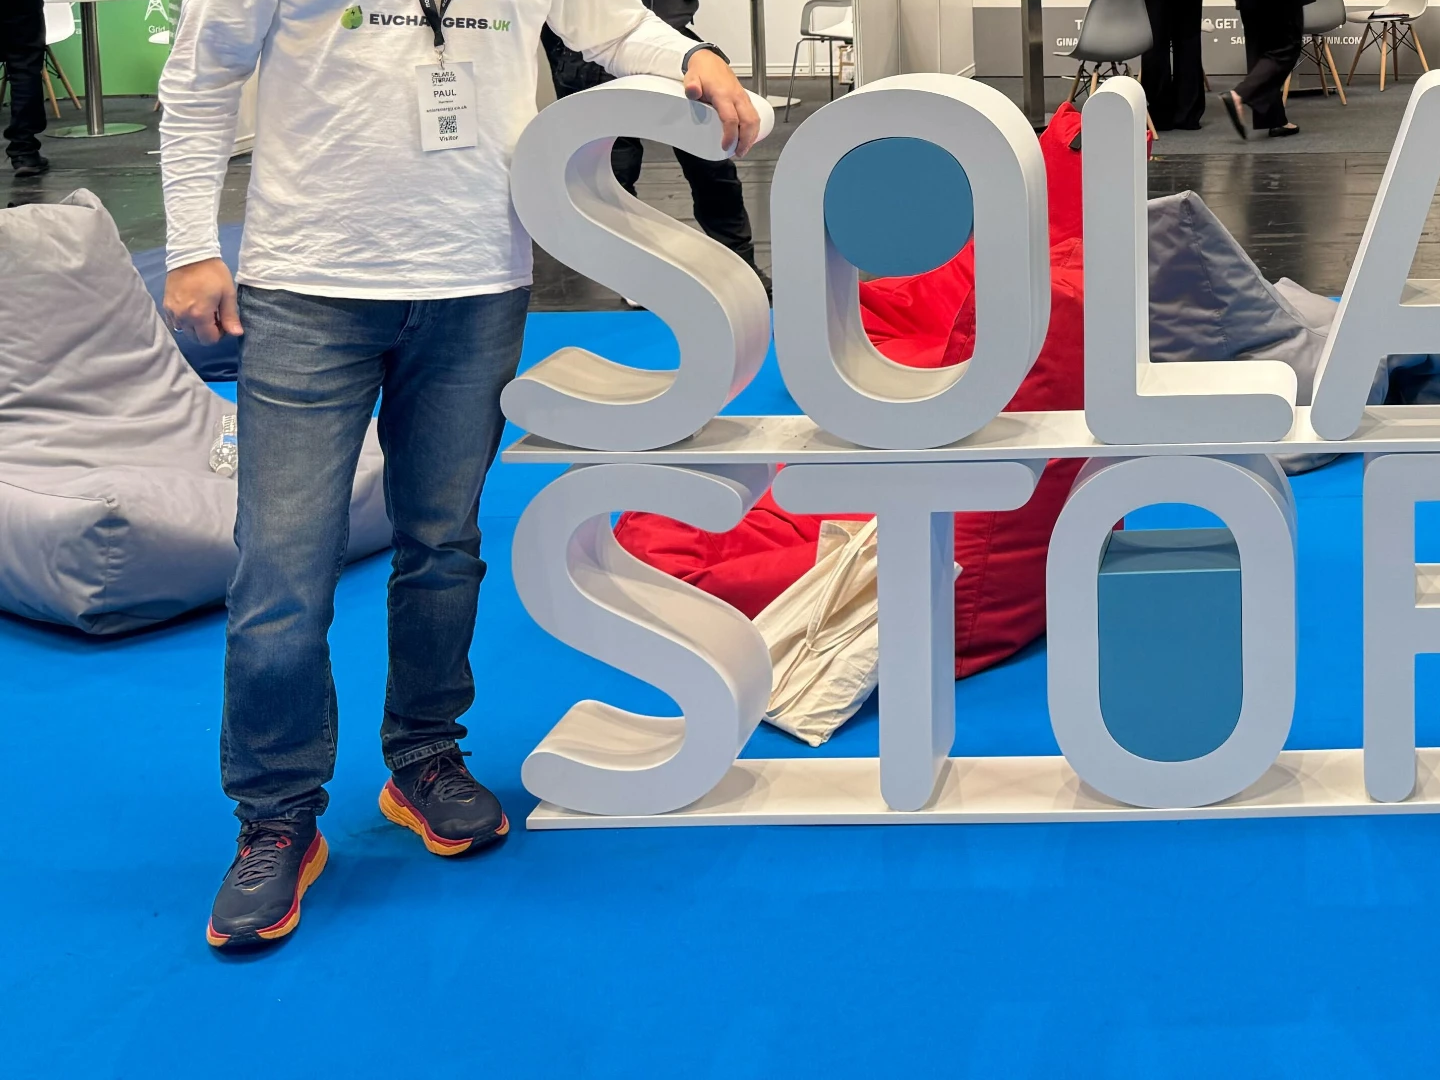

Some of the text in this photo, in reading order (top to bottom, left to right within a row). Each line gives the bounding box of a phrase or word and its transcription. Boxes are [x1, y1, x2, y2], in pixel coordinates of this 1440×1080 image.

[369, 13, 511, 31] EVCHAGERS.UK
[1216, 18, 1238, 29] GET
[148, 24, 166, 34] Grid
[433, 89, 457, 98] PAUL
